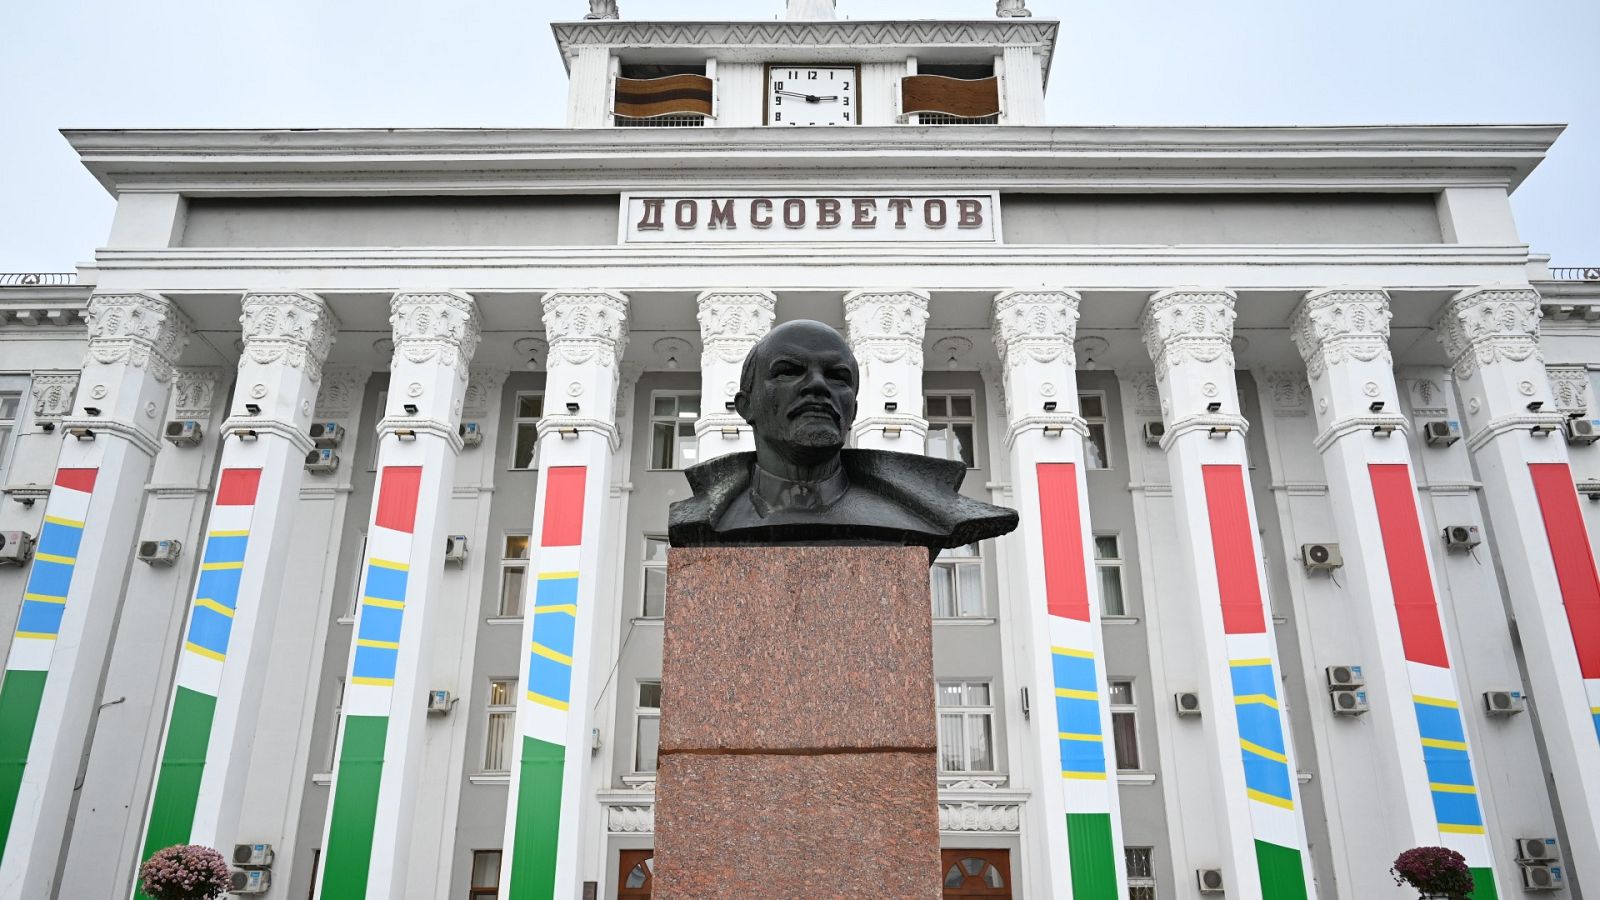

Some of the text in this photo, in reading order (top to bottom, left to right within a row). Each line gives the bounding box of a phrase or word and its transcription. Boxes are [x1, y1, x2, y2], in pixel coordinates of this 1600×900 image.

[788, 70, 834, 80] 11 12 1
[774, 81, 784, 91] 10
[843, 81, 850, 91] 2
[775, 96, 782, 106] 9
[843, 96, 850, 106] 3
[775, 111, 782, 121] 8
[843, 111, 850, 121] 4
